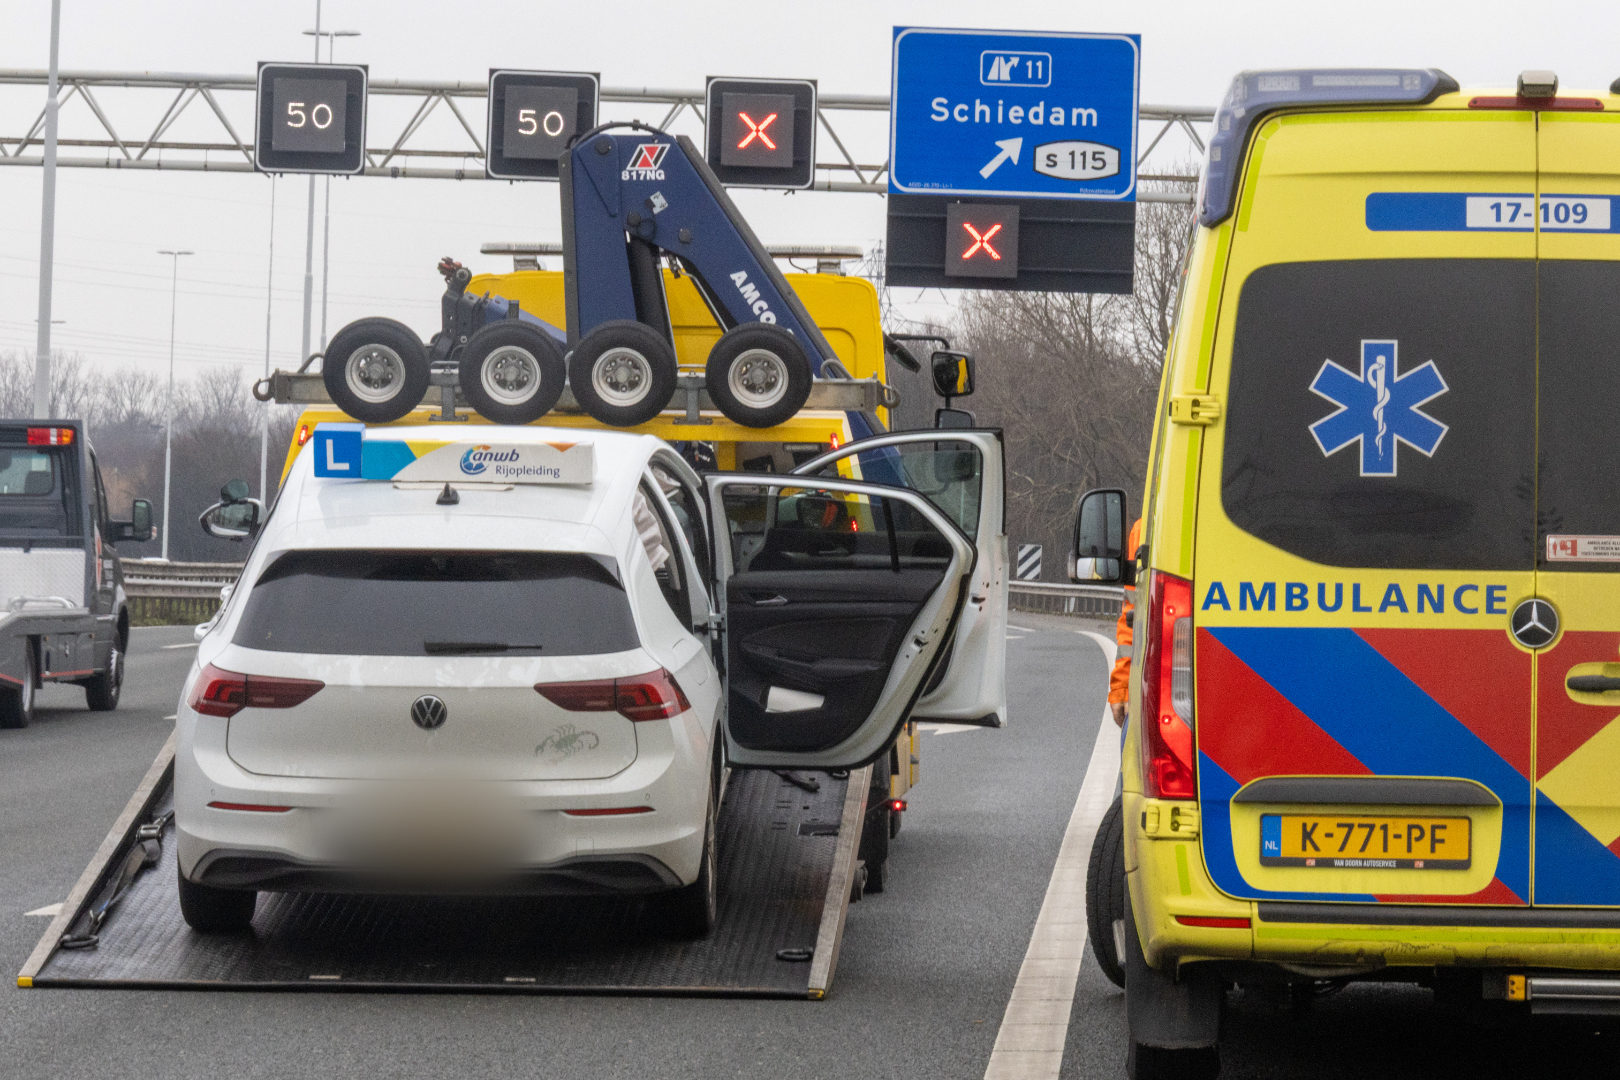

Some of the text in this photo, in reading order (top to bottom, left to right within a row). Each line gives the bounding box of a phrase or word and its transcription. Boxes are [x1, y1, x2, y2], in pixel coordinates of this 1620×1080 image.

[1026, 60, 1042, 80] 11
[287, 102, 332, 129] 50
[518, 109, 564, 137] 50
[930, 97, 1098, 127] Schiedam
[1068, 150, 1107, 171] 115
[621, 169, 665, 181] 817NG
[1490, 202, 1588, 224] 17-109
[729, 270, 777, 325] AMCO
[326, 438, 350, 471] L
[473, 448, 520, 462] anwb
[495, 464, 561, 479] Rijopleiding
[1201, 581, 1508, 615] AMBULANCE
[1264, 840, 1279, 851] NL
[1301, 822, 1447, 853] K-771-PF
[1334, 859, 1397, 868] VAN DOORN AUTOSERVICE
